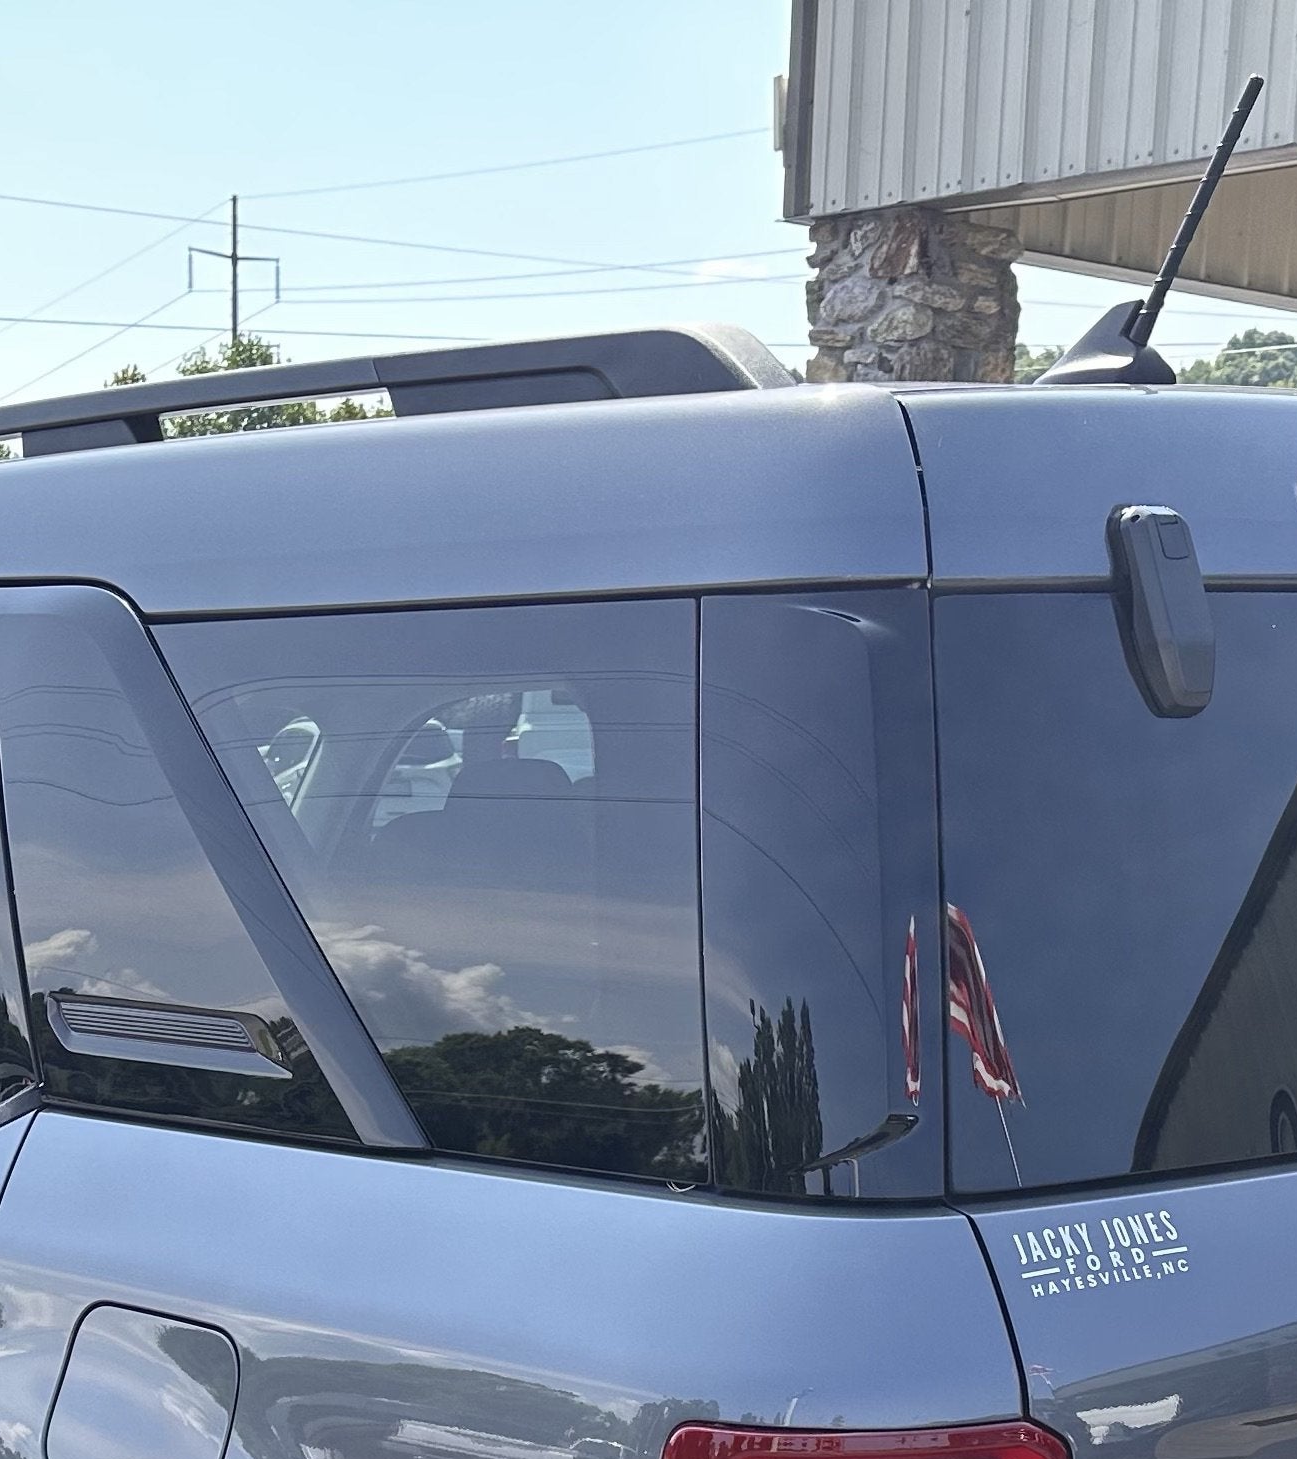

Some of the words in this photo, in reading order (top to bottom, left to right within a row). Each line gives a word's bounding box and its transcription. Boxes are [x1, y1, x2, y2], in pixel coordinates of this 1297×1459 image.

[1012, 1222, 1094, 1266] JACKY
[1102, 1210, 1179, 1251] JONES
[1066, 1246, 1146, 1275] FORD
